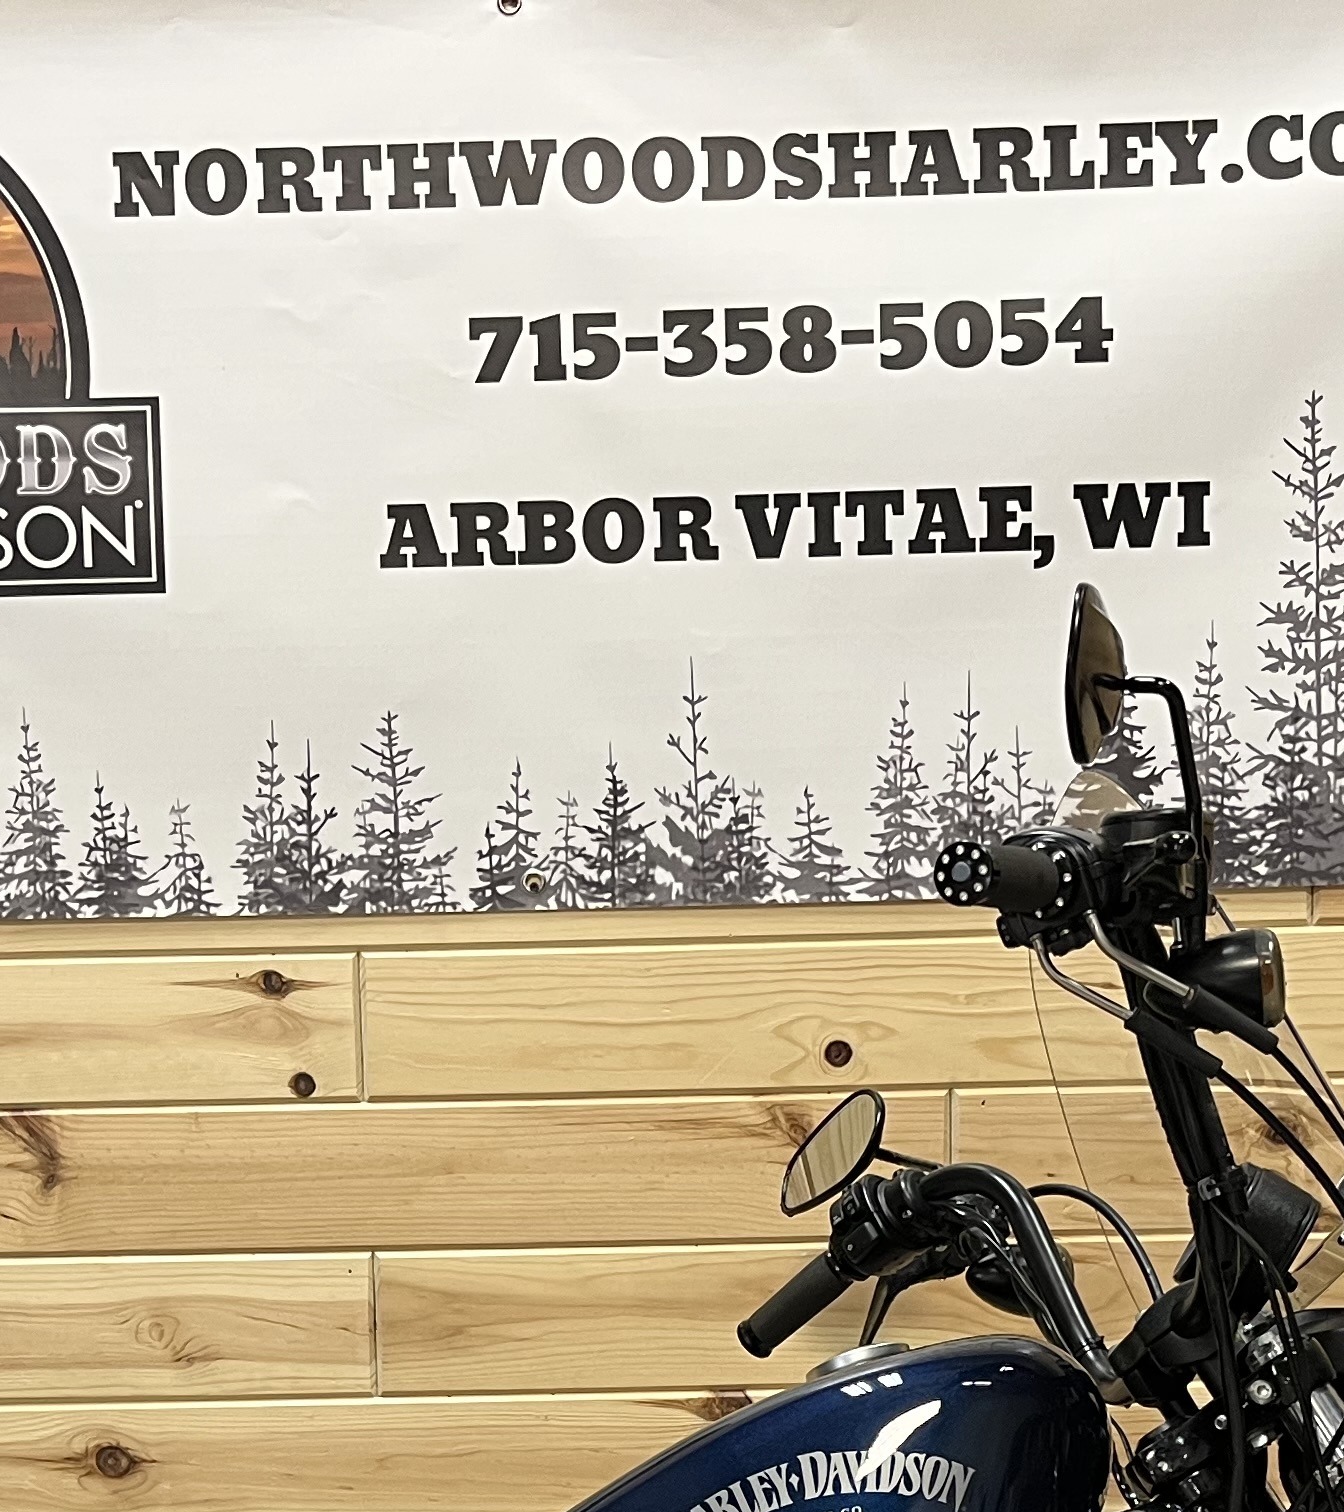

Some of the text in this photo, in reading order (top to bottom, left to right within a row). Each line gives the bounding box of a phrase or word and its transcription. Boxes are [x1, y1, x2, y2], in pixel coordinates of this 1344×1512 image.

[468, 296, 1114, 384] 715-358-5054
[379, 480, 1211, 570] ARBOR VITAE, WI
